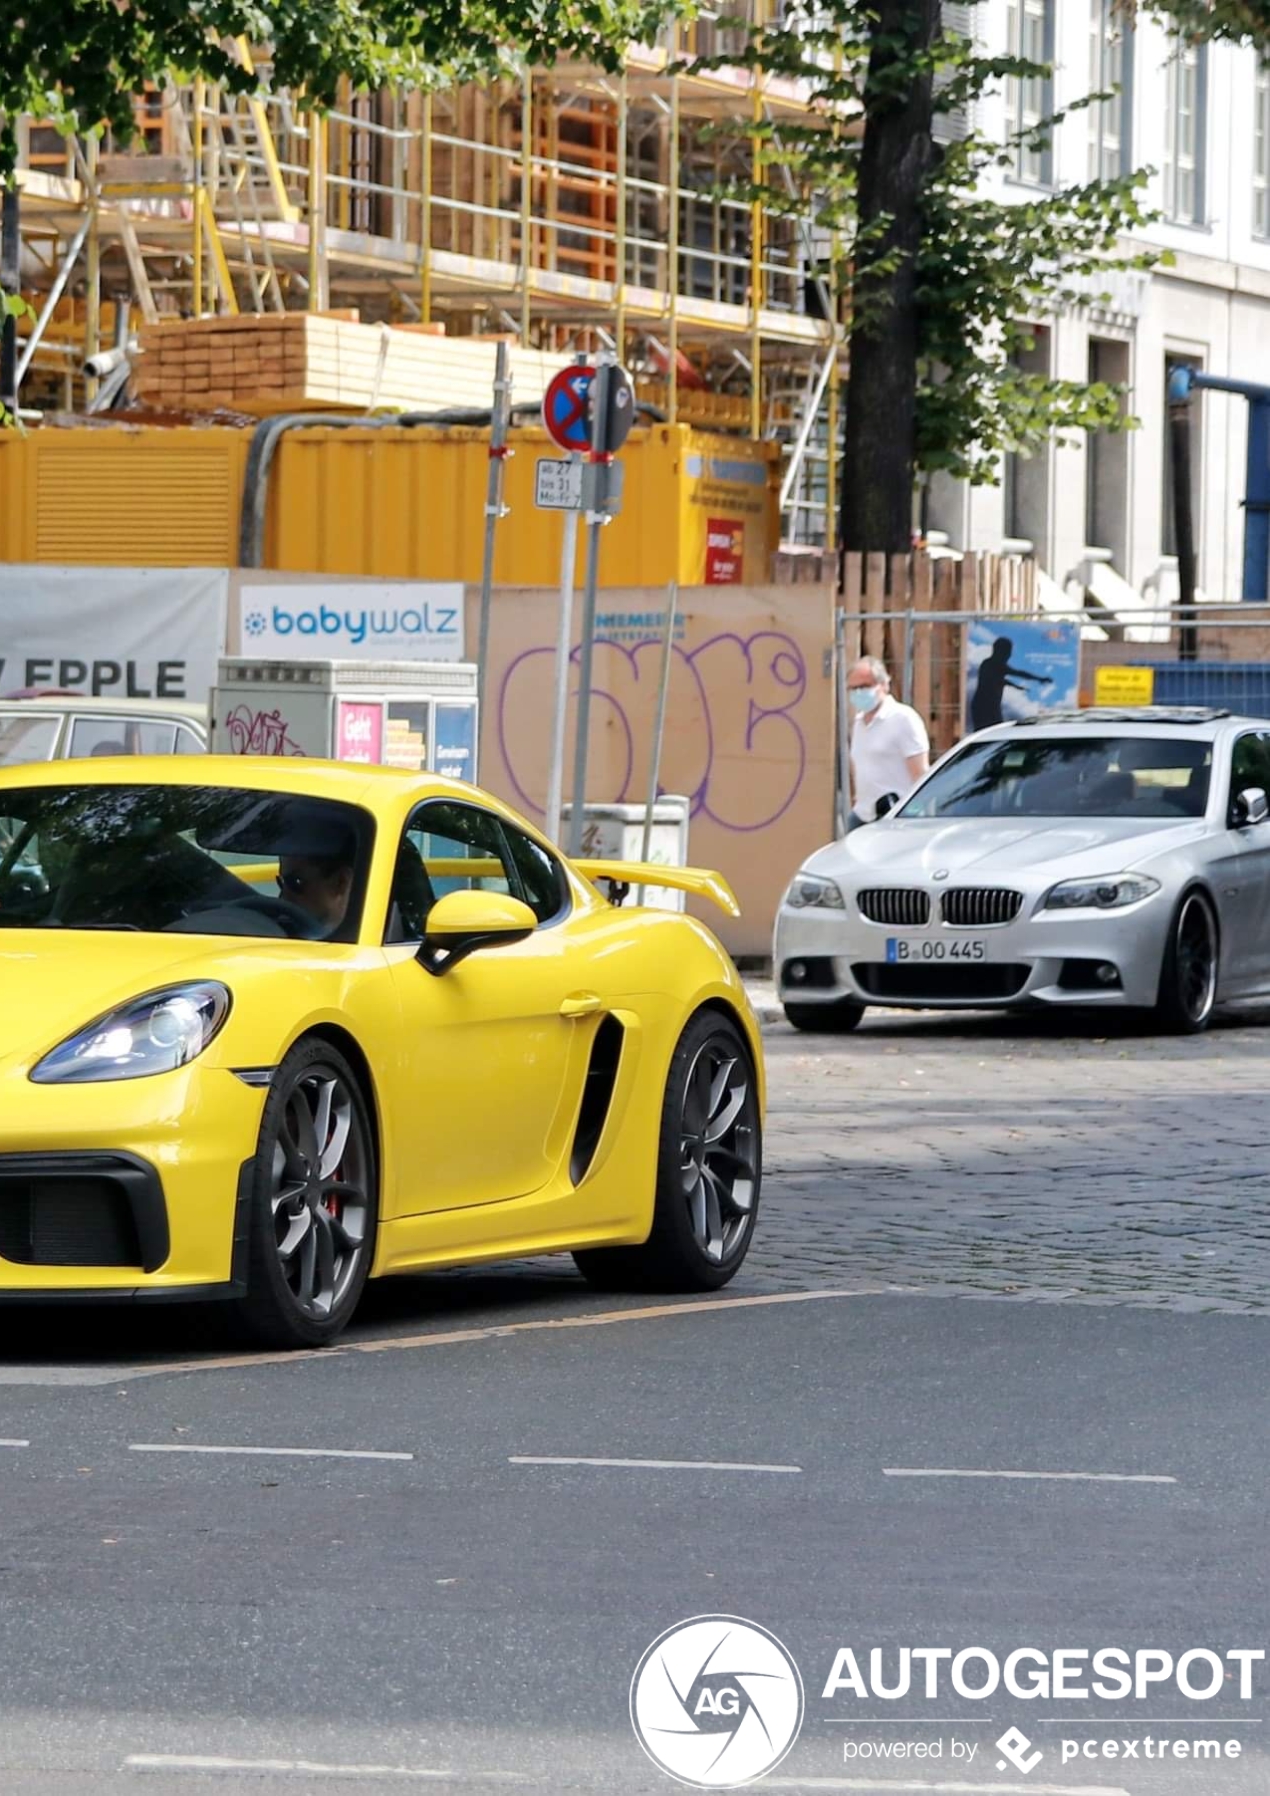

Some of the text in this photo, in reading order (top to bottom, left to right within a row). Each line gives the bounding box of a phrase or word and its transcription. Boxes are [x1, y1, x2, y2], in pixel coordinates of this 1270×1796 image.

[272, 601, 458, 644] babywalz
[25, 659, 187, 699] EPPLE
[898, 940, 910, 960] B
[949, 940, 984, 960] 445
